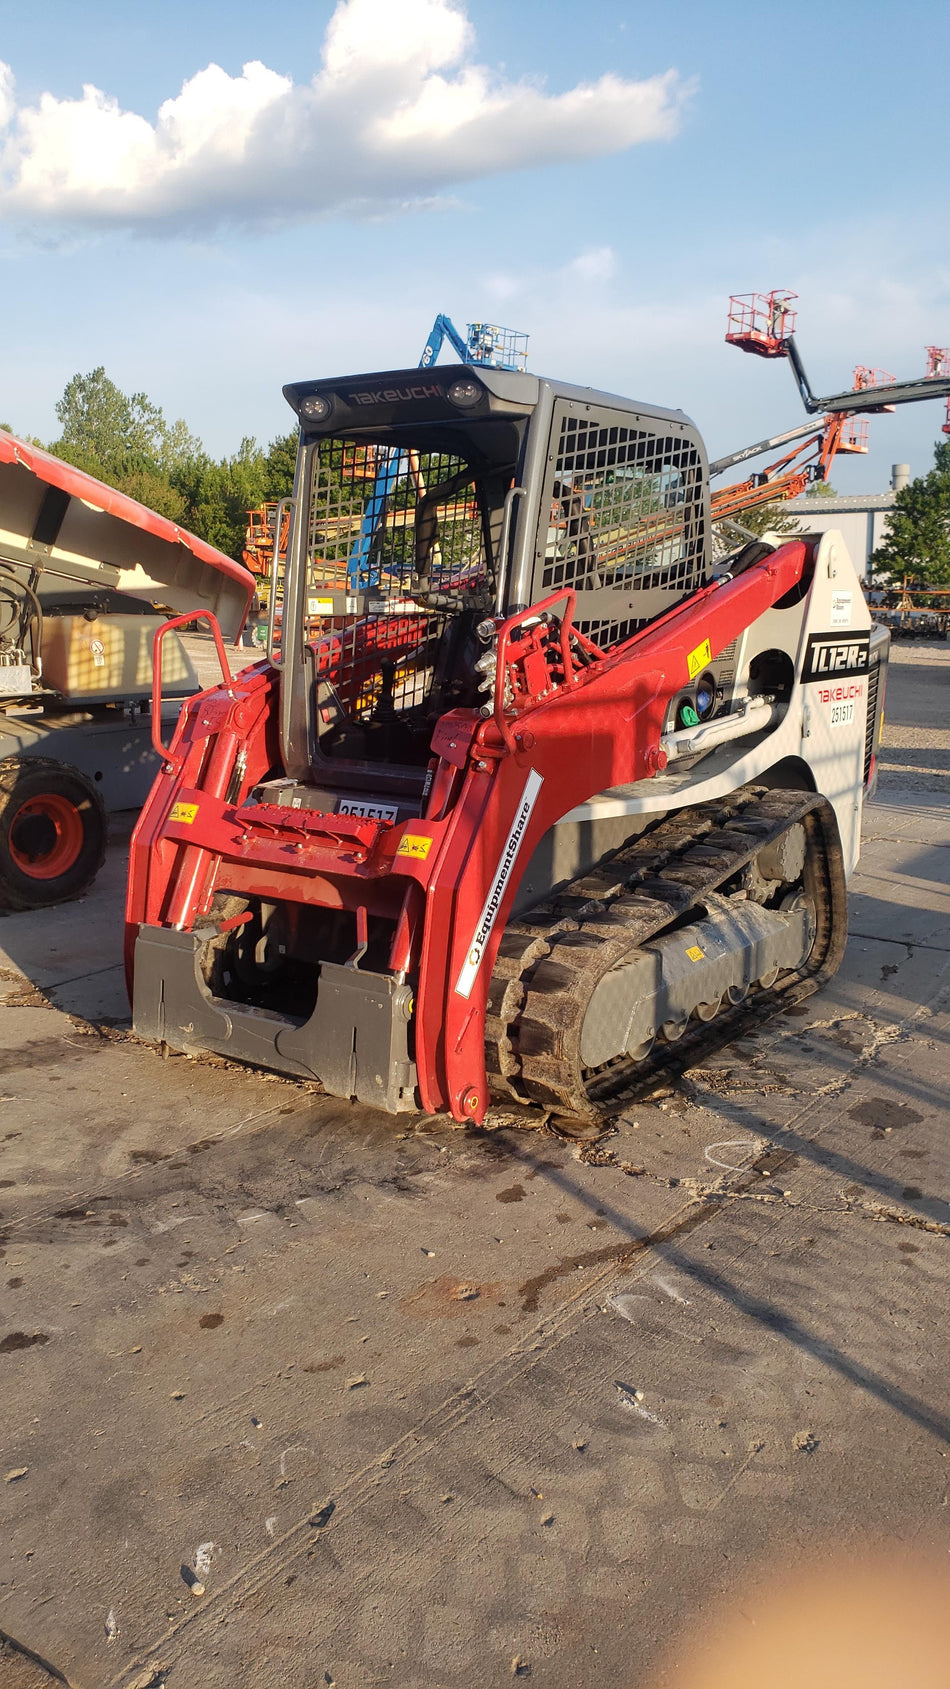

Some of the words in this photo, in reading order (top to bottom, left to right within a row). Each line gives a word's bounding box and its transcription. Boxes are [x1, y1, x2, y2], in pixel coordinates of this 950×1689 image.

[348, 384, 443, 404] TAKEUCHI
[818, 685, 863, 703] TAKEUCHI
[831, 704, 853, 724] 251517
[476, 801, 530, 946] EquipmentShare
